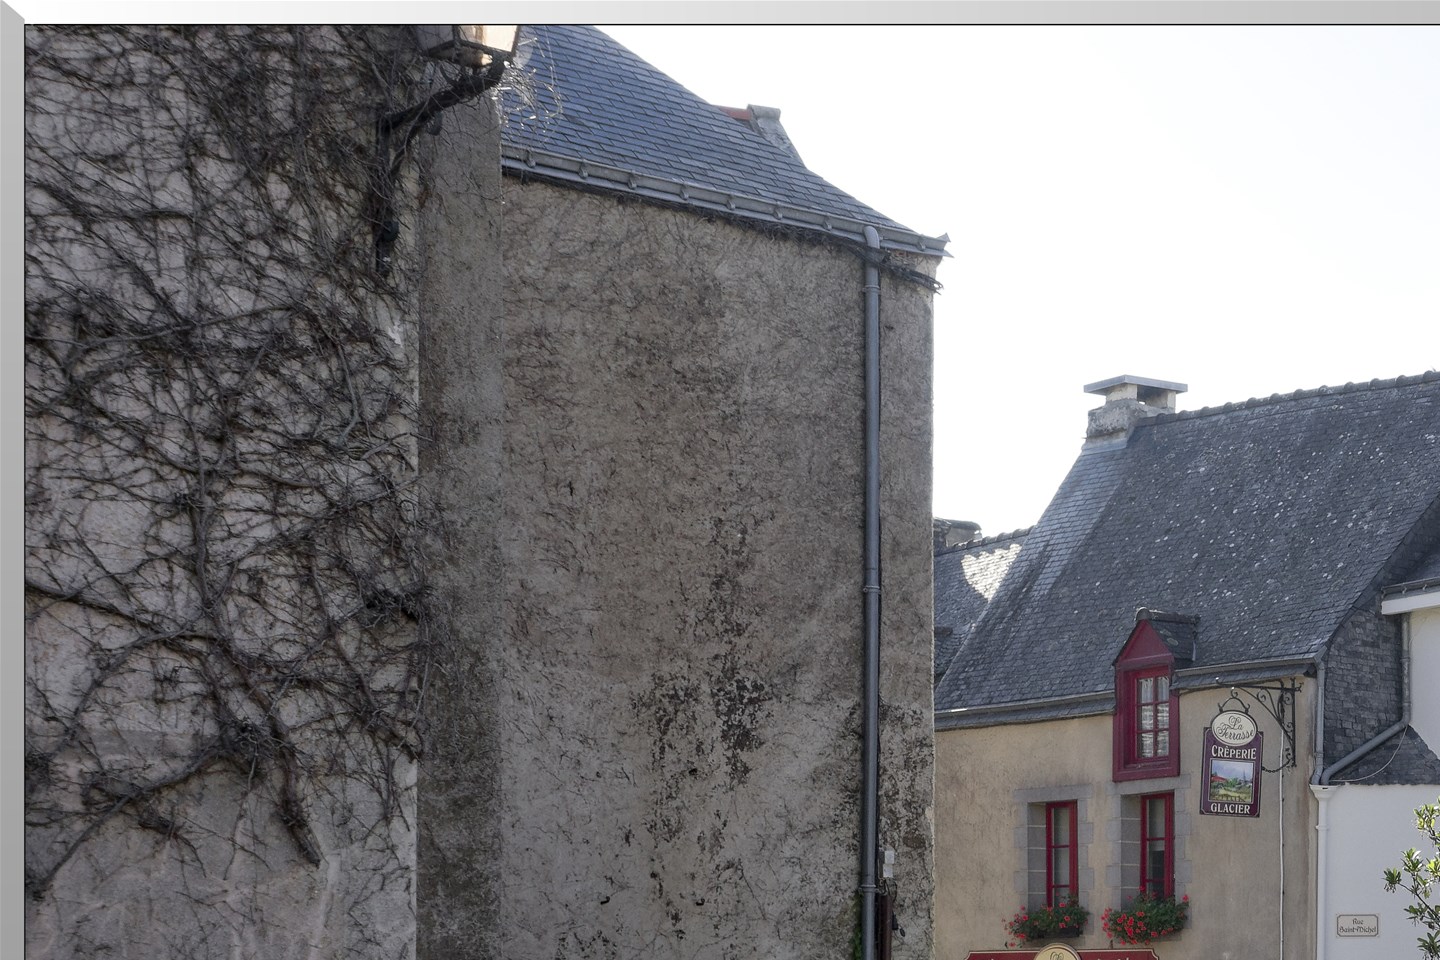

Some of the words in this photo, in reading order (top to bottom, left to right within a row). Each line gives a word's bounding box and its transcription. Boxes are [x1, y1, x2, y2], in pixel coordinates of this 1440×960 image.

[1228, 715, 1243, 730] La
[1216, 722, 1254, 741] Terrasse
[1211, 744, 1257, 760] CRÊPERIE
[1210, 803, 1251, 814] GLACIER
[1352, 917, 1364, 925] Rue
